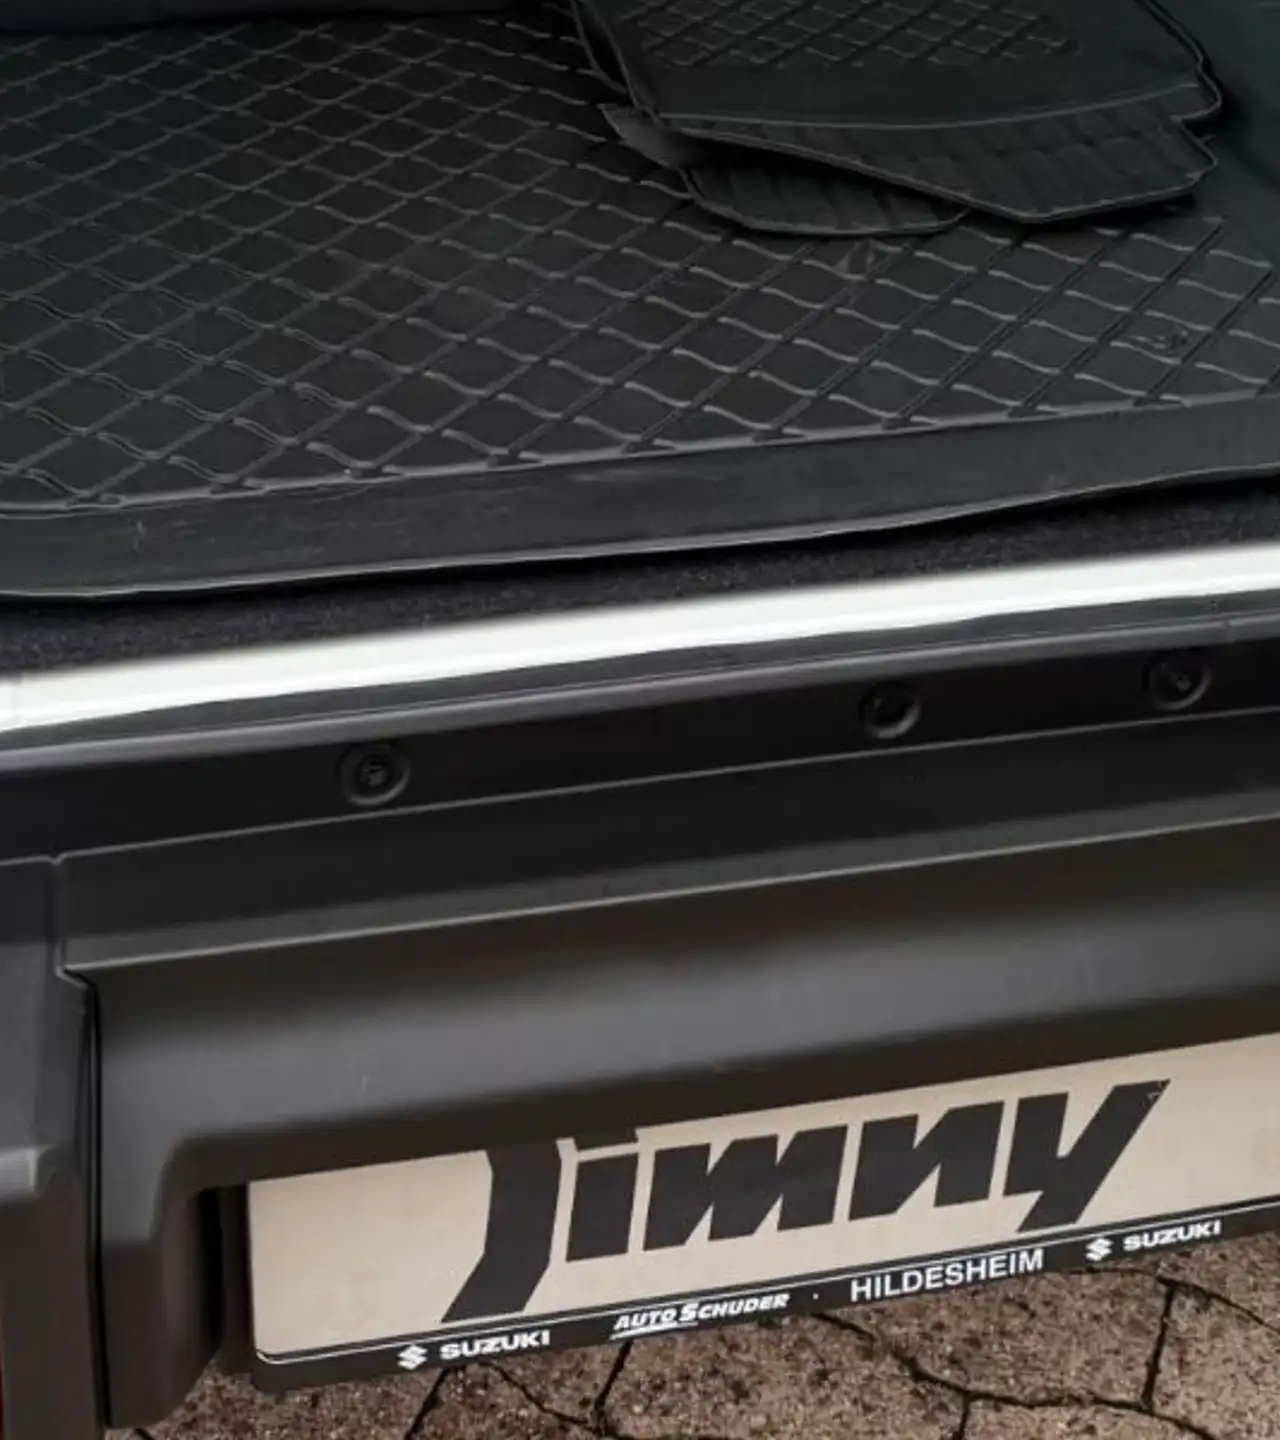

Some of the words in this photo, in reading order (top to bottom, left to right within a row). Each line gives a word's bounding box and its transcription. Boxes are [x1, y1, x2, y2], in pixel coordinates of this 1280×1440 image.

[1122, 1219, 1223, 1252] SUZUKI
[613, 1309, 677, 1331] AUTO
[679, 1292, 791, 1324] SCHUDER
[850, 1248, 1045, 1302] HILDESHEIM
[439, 1330, 551, 1360] SUZUKI
